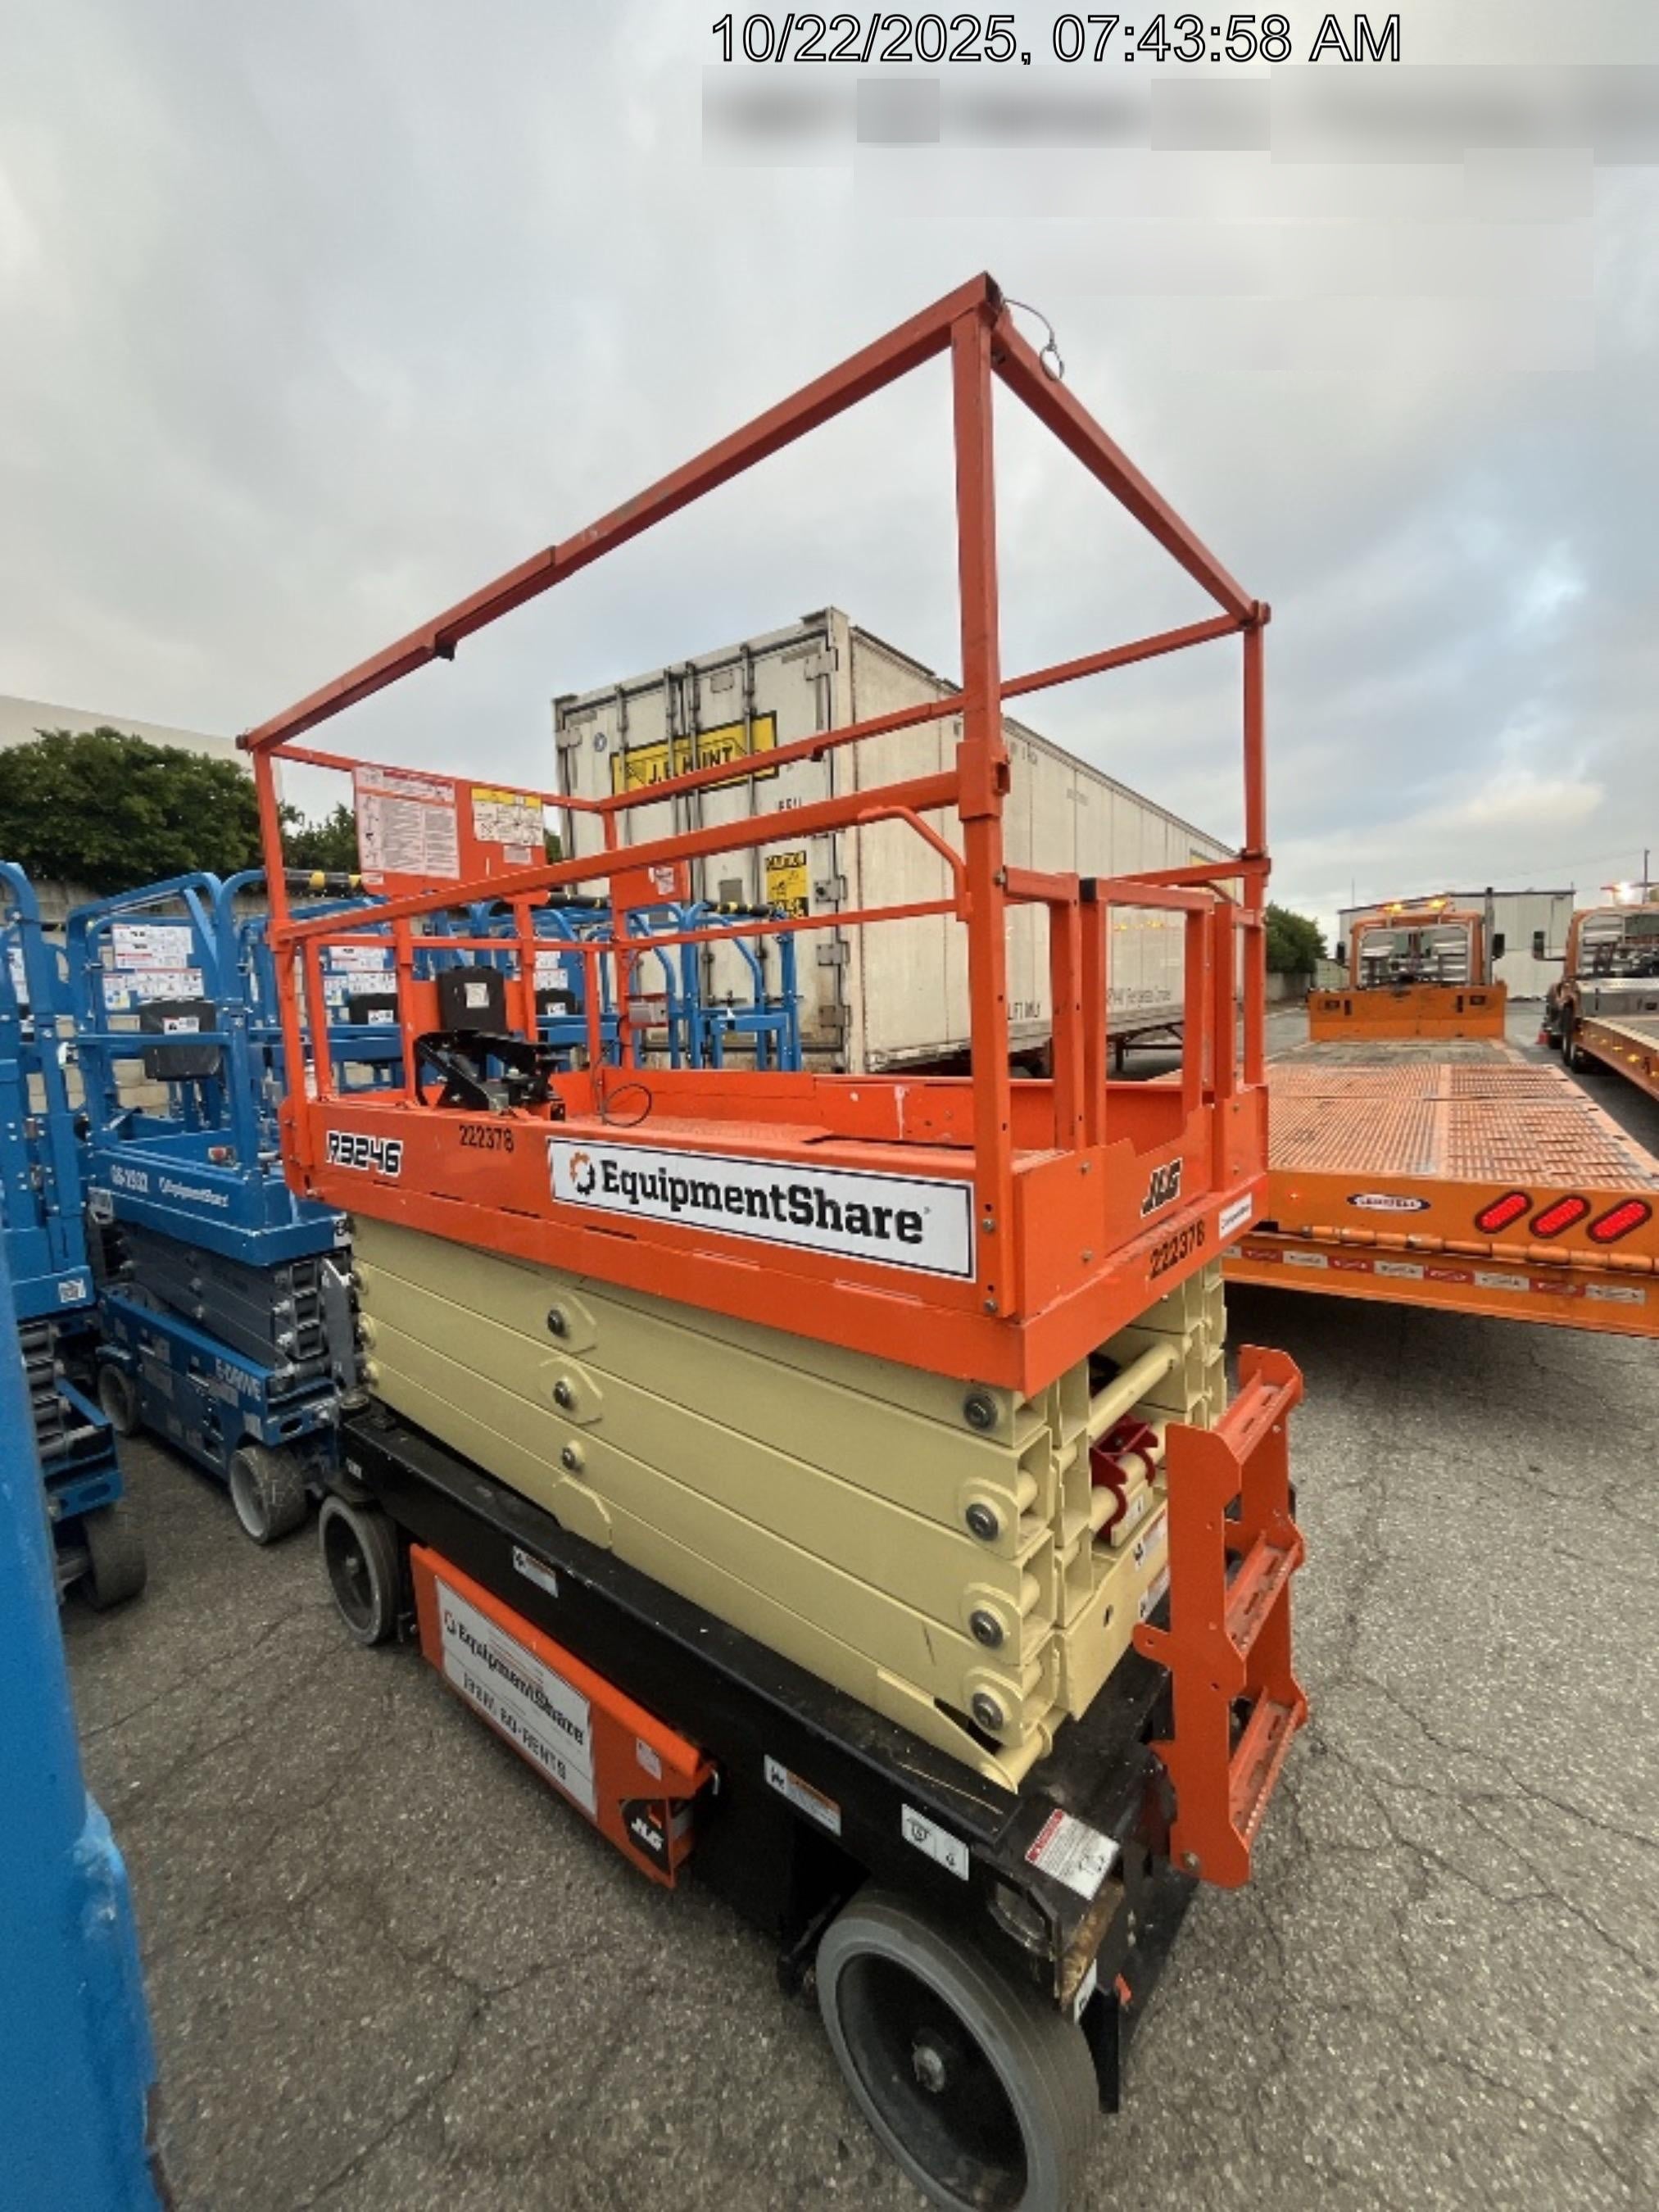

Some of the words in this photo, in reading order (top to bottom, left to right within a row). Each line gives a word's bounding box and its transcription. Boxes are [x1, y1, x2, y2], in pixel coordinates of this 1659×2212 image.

[326, 1130, 404, 1178] R3246
[459, 1124, 514, 1153] 222378
[600, 1158, 923, 1244] EquipmentShare
[1149, 1219, 1205, 1281] 222378
[458, 1625, 584, 1746] EquipmentShare
[630, 1816, 664, 1852] JLG
